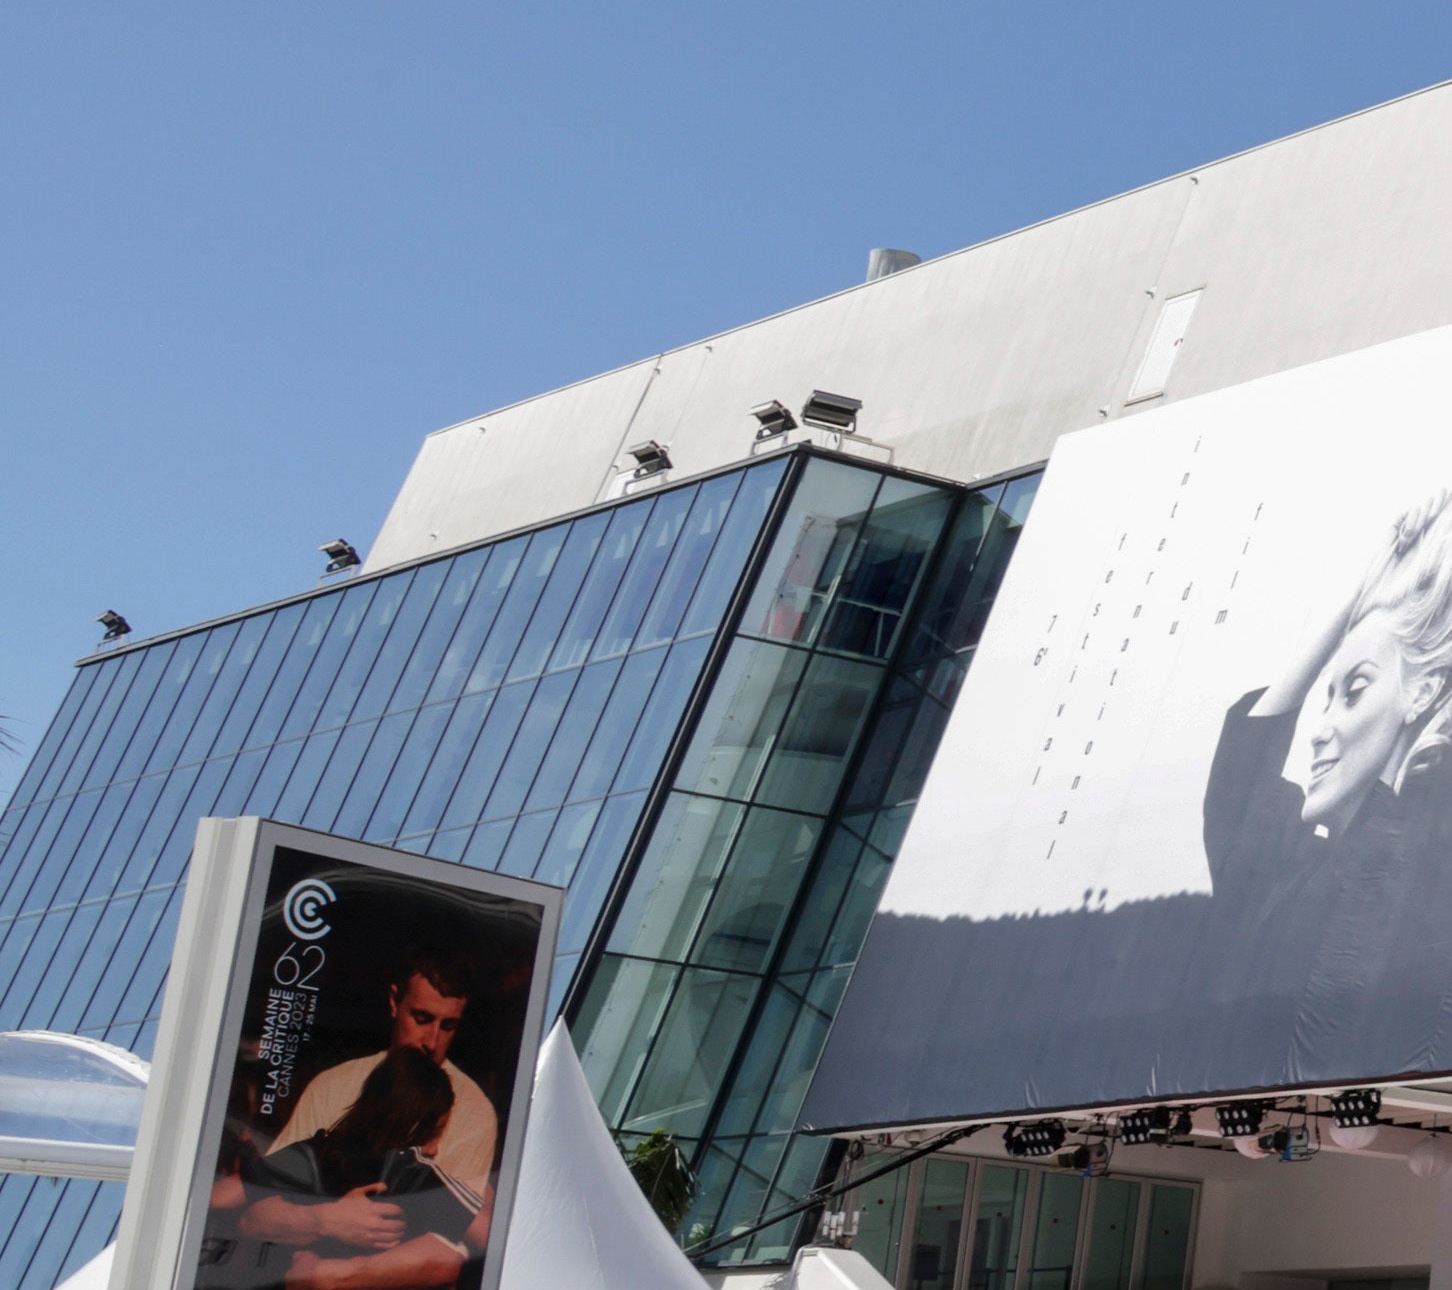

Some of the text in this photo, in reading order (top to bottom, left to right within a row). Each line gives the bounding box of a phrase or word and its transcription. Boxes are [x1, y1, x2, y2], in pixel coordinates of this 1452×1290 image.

[1168, 581, 1193, 635] du
[1214, 502, 1264, 625] film
[1032, 532, 1128, 786] festival
[1046, 435, 1202, 860] international
[258, 988, 282, 1059] SEMAINE
[260, 990, 295, 1115] DE LA CRITIQUE
[277, 992, 307, 1098] CANNES 2023
